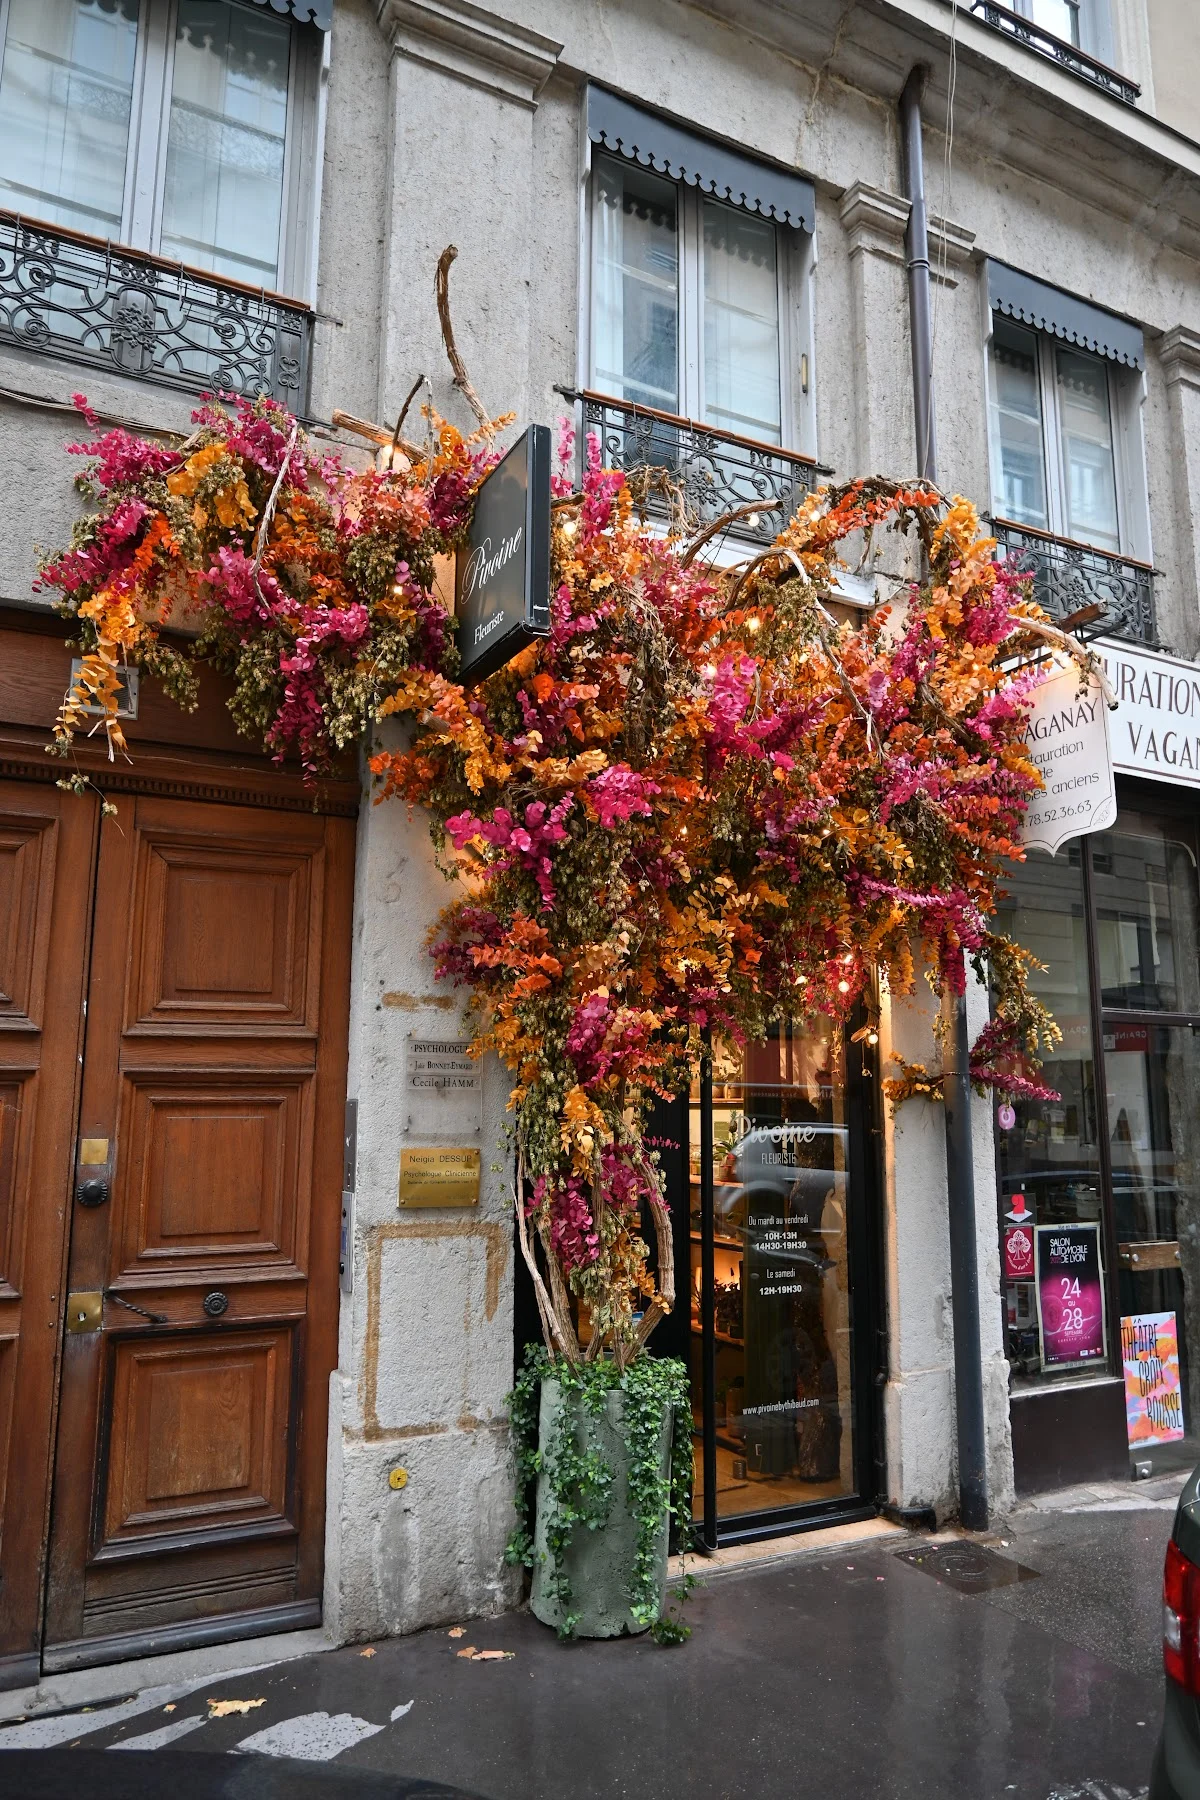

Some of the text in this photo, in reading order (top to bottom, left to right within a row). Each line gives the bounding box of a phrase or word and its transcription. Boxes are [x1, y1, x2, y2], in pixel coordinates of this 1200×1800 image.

[461, 527, 522, 605] Pivoine
[474, 610, 504, 645] Fleuriste
[1051, 772, 1100, 795] anciens
[443, 1077, 474, 1088] HAMM
[733, 1114, 817, 1145] Pivoine
[761, 1152, 796, 1165] FLEURISTE
[748, 1216, 756, 1225] Du
[757, 1215, 774, 1225] mardi
[784, 1214, 809, 1224] vendredi
[764, 1231, 798, 1241] 10H-13H
[1049, 1237, 1070, 1247] SALON
[755, 1241, 807, 1251] 14H30-19H30
[1049, 1244, 1088, 1256] AUTOMOBILE
[1070, 1253, 1086, 1263] LYON
[766, 1267, 796, 1279] Le samedi
[759, 1284, 803, 1296] 12H-19H30
[1060, 1276, 1082, 1300] 24
[1062, 1307, 1084, 1331] 28
[1121, 1318, 1160, 1362] THÉÂTRE
[1139, 1358, 1164, 1397] CROIX
[742, 1397, 820, 1415] www.pivoinebythibaud.com
[1146, 1392, 1182, 1433] ROUSSE
